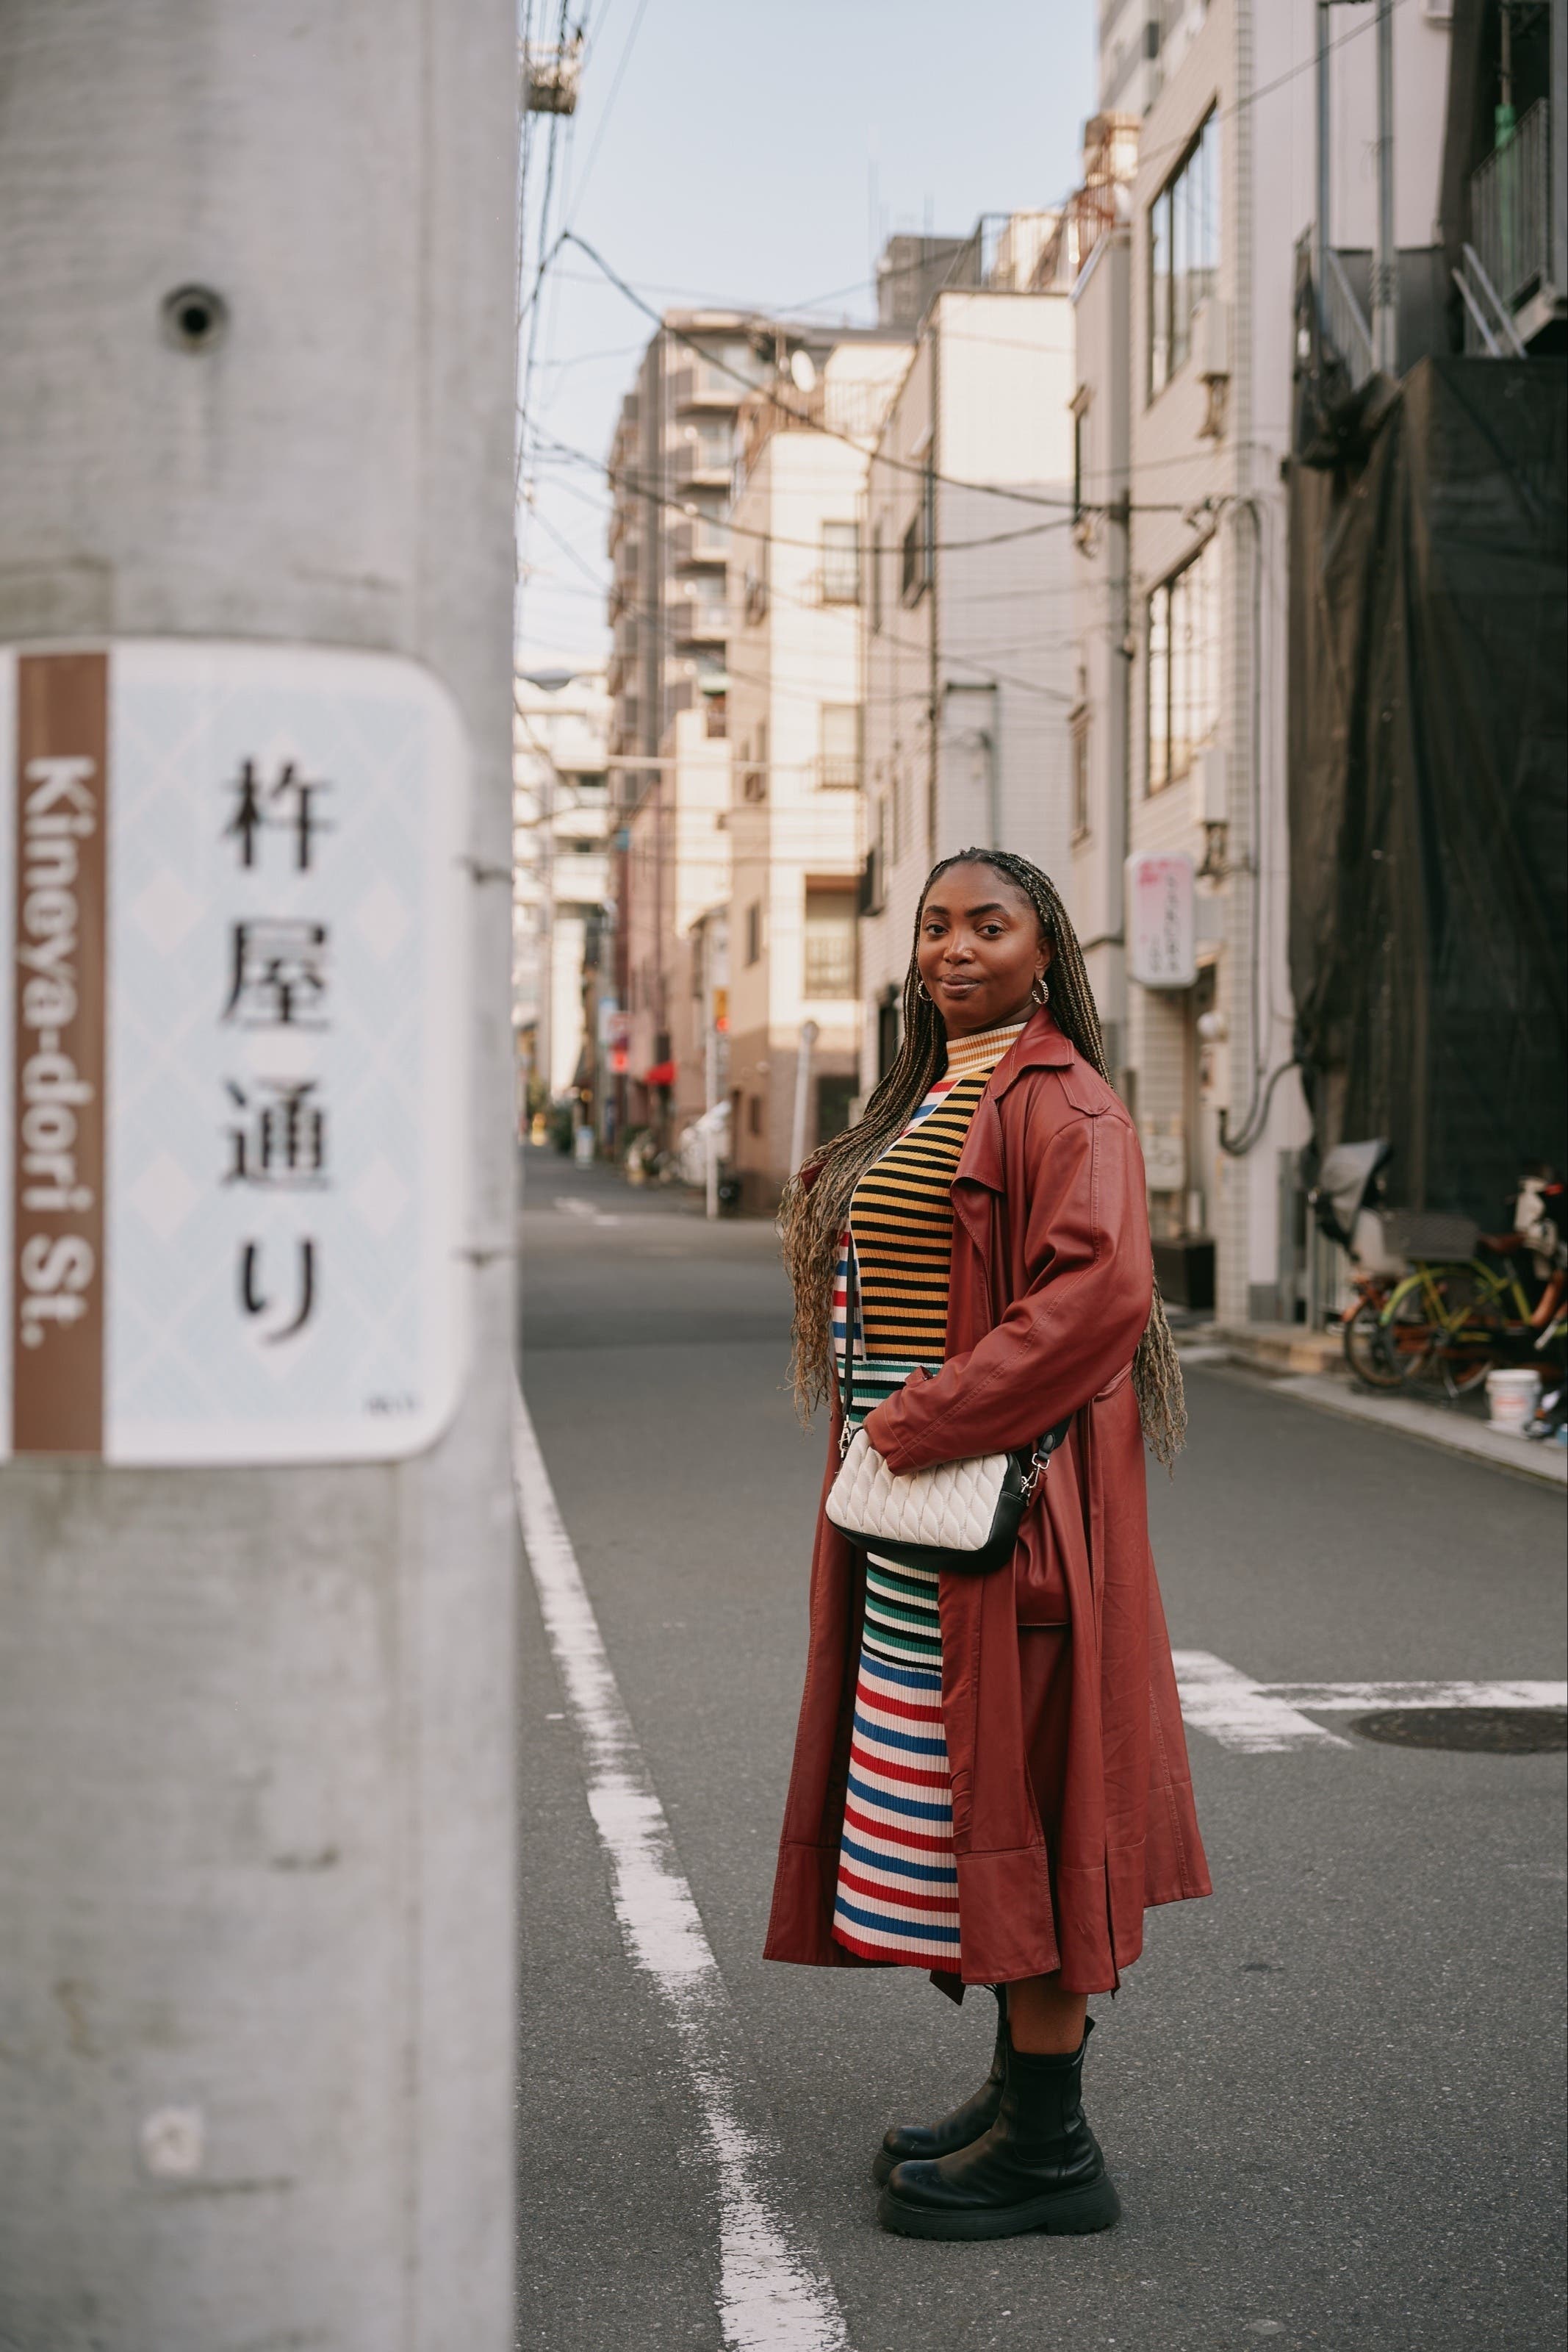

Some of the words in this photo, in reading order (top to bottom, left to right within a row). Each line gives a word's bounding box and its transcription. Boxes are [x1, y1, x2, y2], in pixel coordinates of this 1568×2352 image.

[21, 757, 93, 1211] Kineya-dori
[222, 757, 332, 1345] 杵屋通り
[24, 1236, 93, 1347] St.
